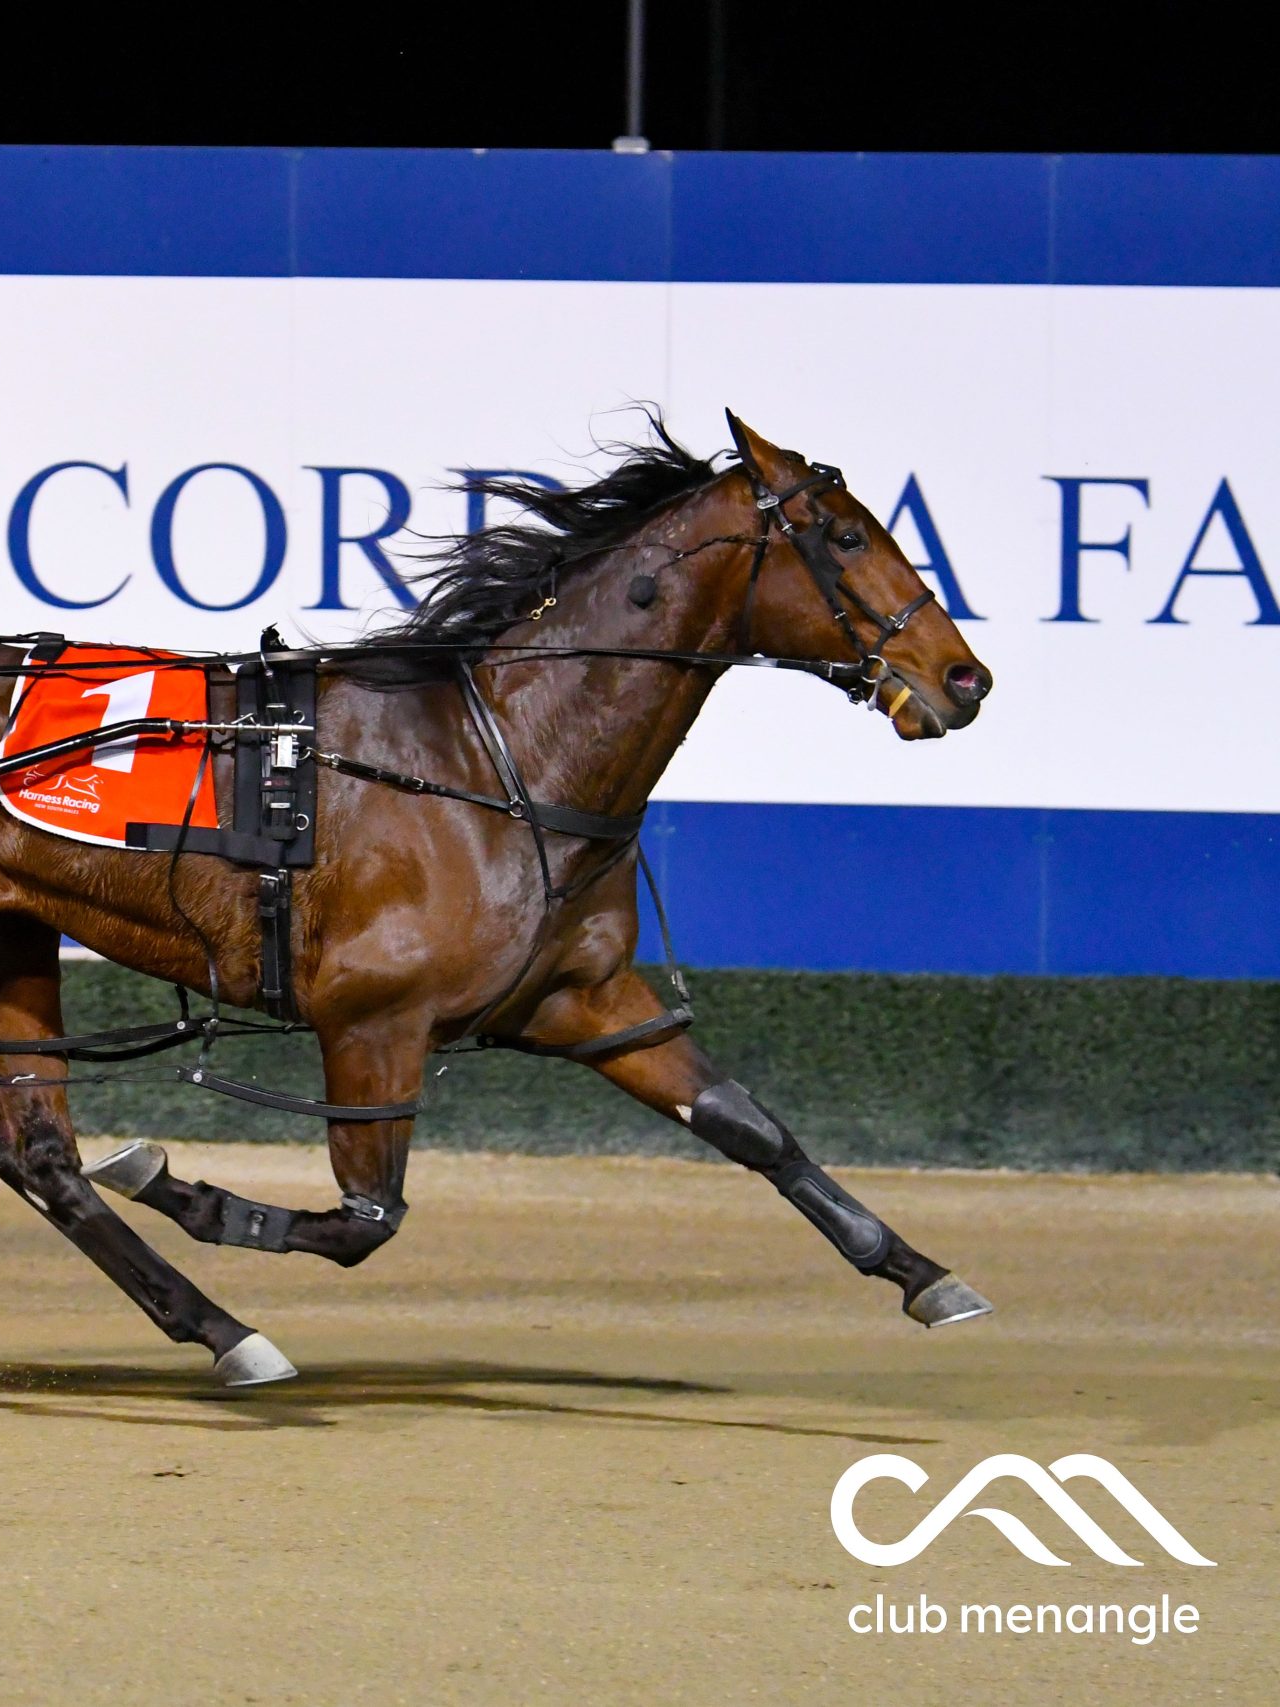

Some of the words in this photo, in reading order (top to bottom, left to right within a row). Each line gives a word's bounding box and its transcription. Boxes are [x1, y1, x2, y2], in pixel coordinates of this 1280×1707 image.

[81, 670, 155, 774] 1
[19, 789, 62, 805] Harness
[62, 796, 100, 814] Racing
